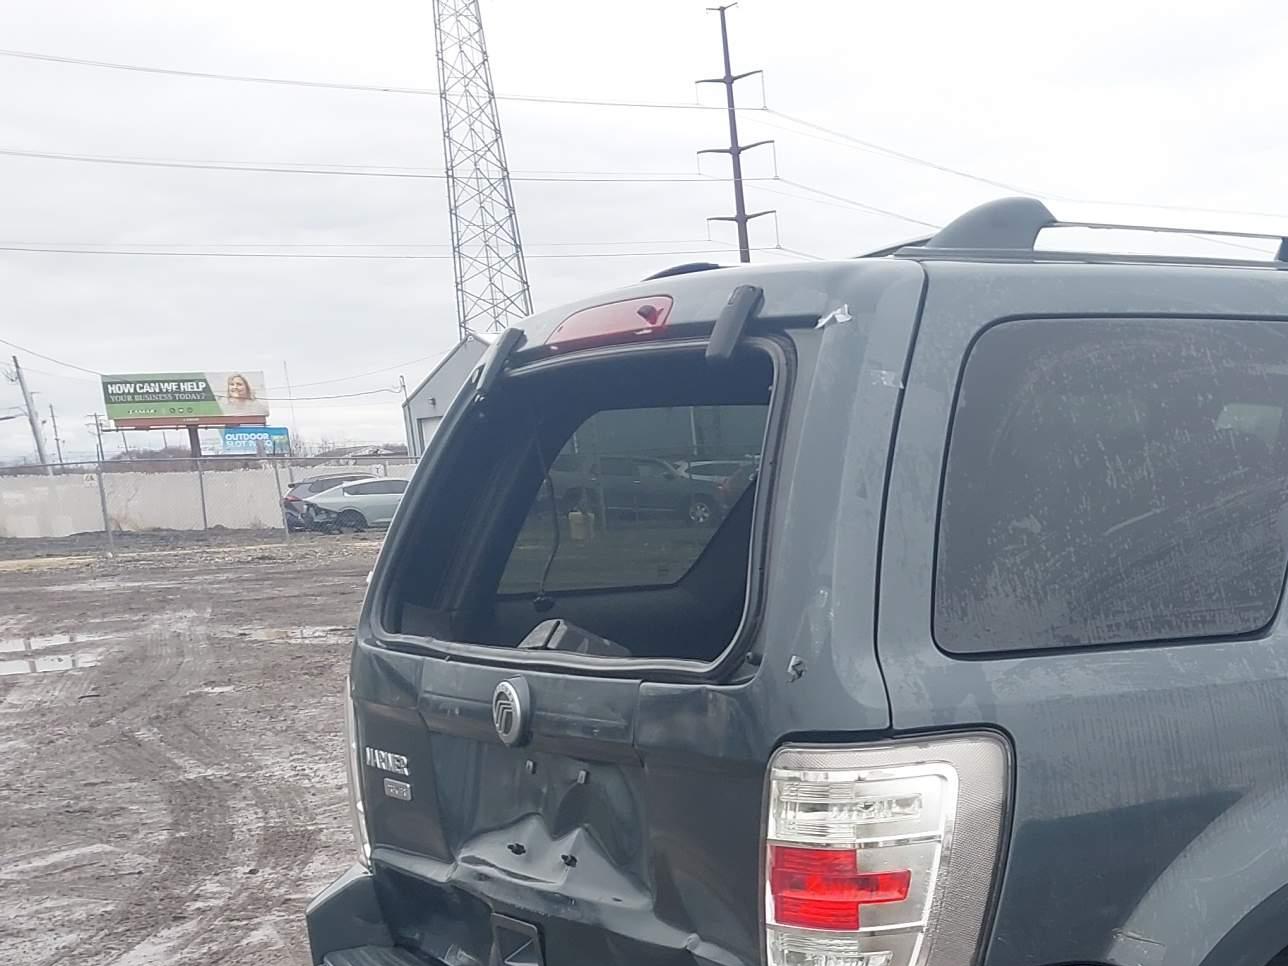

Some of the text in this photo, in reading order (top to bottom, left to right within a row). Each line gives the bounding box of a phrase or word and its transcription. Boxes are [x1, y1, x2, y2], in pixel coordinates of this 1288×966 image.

[107, 381, 206, 394] HOW CAN WE HELP
[109, 394, 132, 402] YOUR
[134, 393, 173, 401] BUSINESS
[225, 433, 270, 441] OUTDOOR
